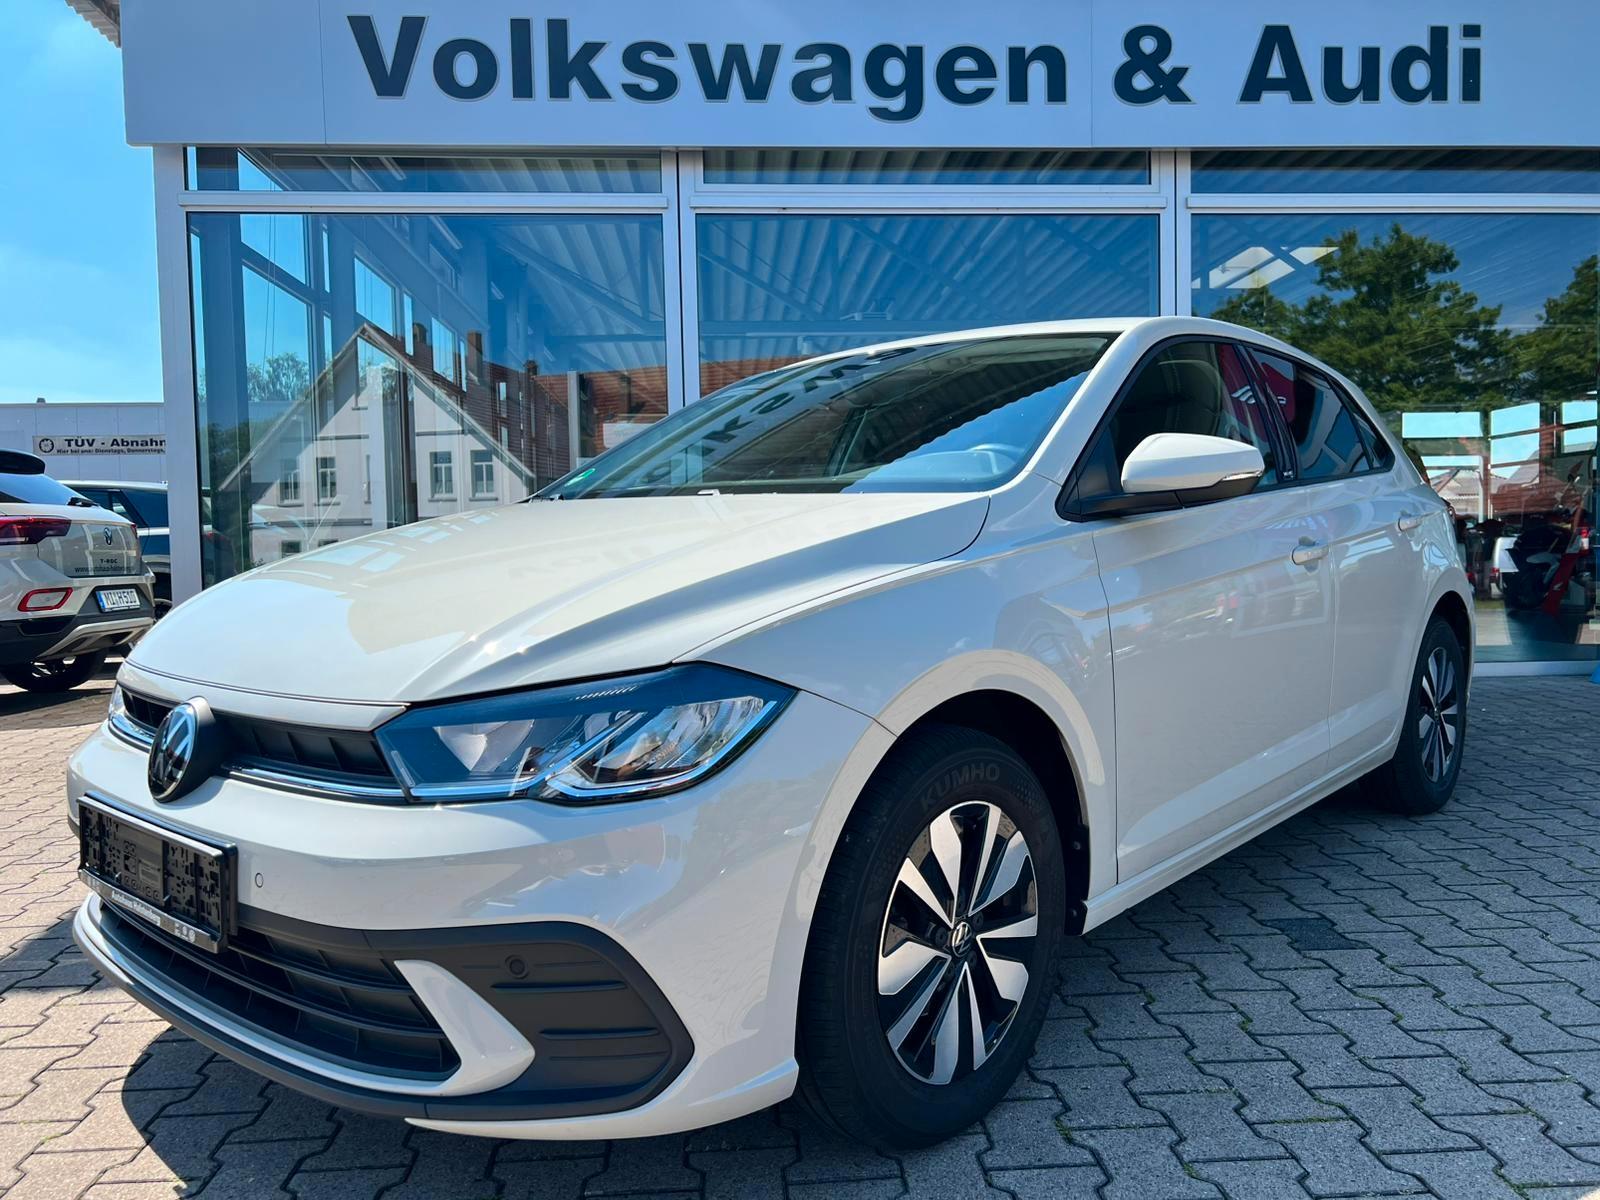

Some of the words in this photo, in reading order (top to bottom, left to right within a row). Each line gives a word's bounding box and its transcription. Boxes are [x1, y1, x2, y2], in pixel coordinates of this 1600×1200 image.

[347, 15, 1065, 122] Volkswagen
[1112, 24, 1196, 105] &
[1237, 24, 1482, 105] Audi
[64, 436, 95, 447] TÜV
[921, 762, 1000, 811] KUMHO
